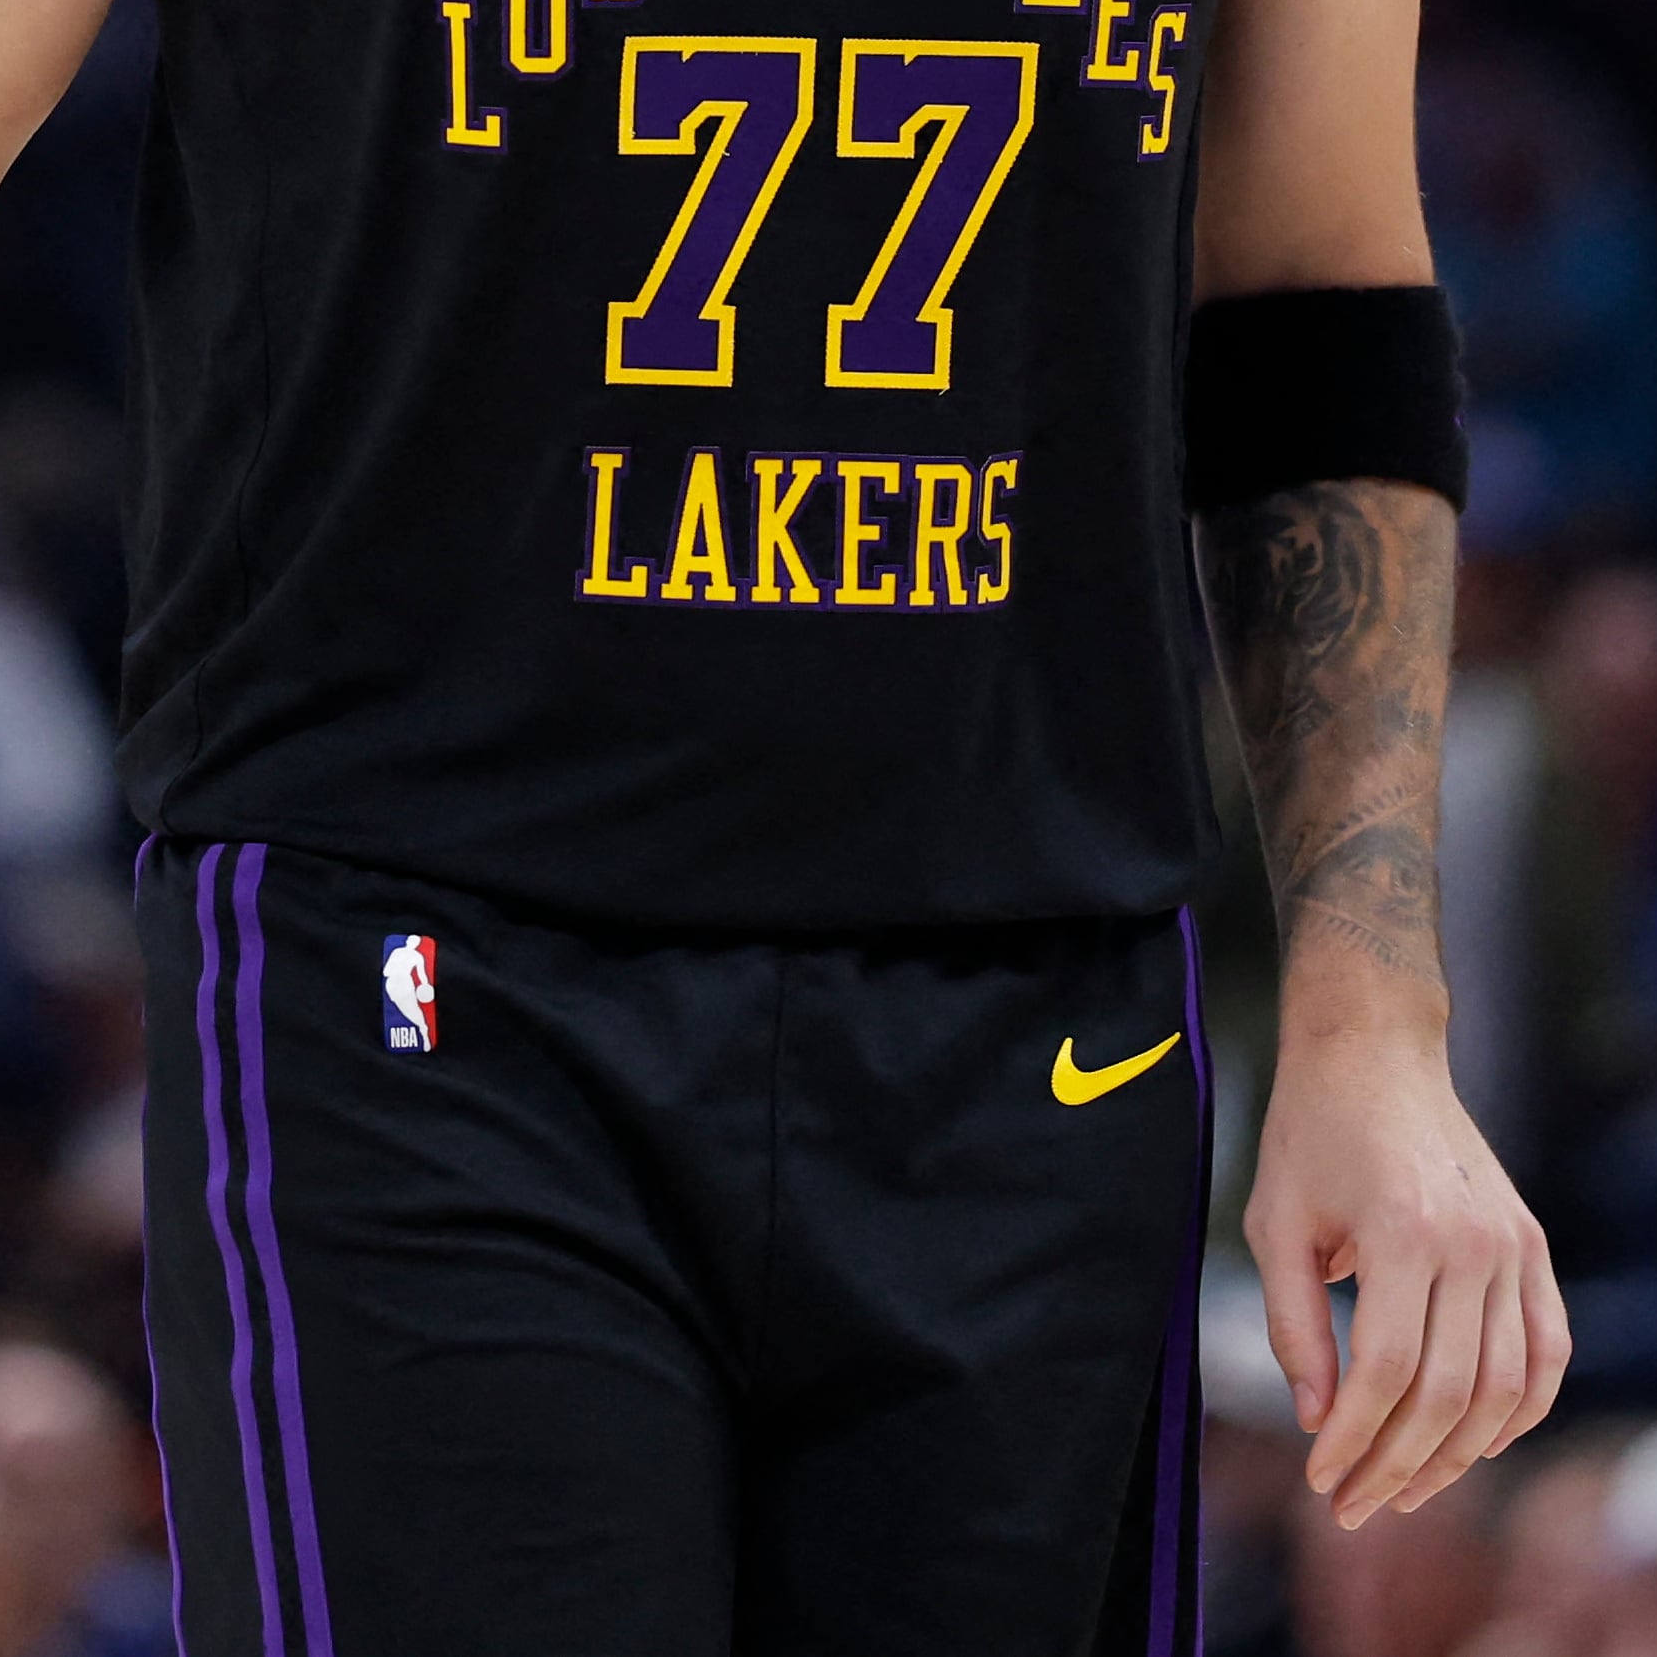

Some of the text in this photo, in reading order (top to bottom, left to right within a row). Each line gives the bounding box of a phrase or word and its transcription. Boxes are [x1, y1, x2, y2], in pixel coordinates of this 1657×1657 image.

[605, 36, 1040, 391] 77
[574, 446, 1023, 614] LAKERS
[390, 1026, 419, 1049] NBA
